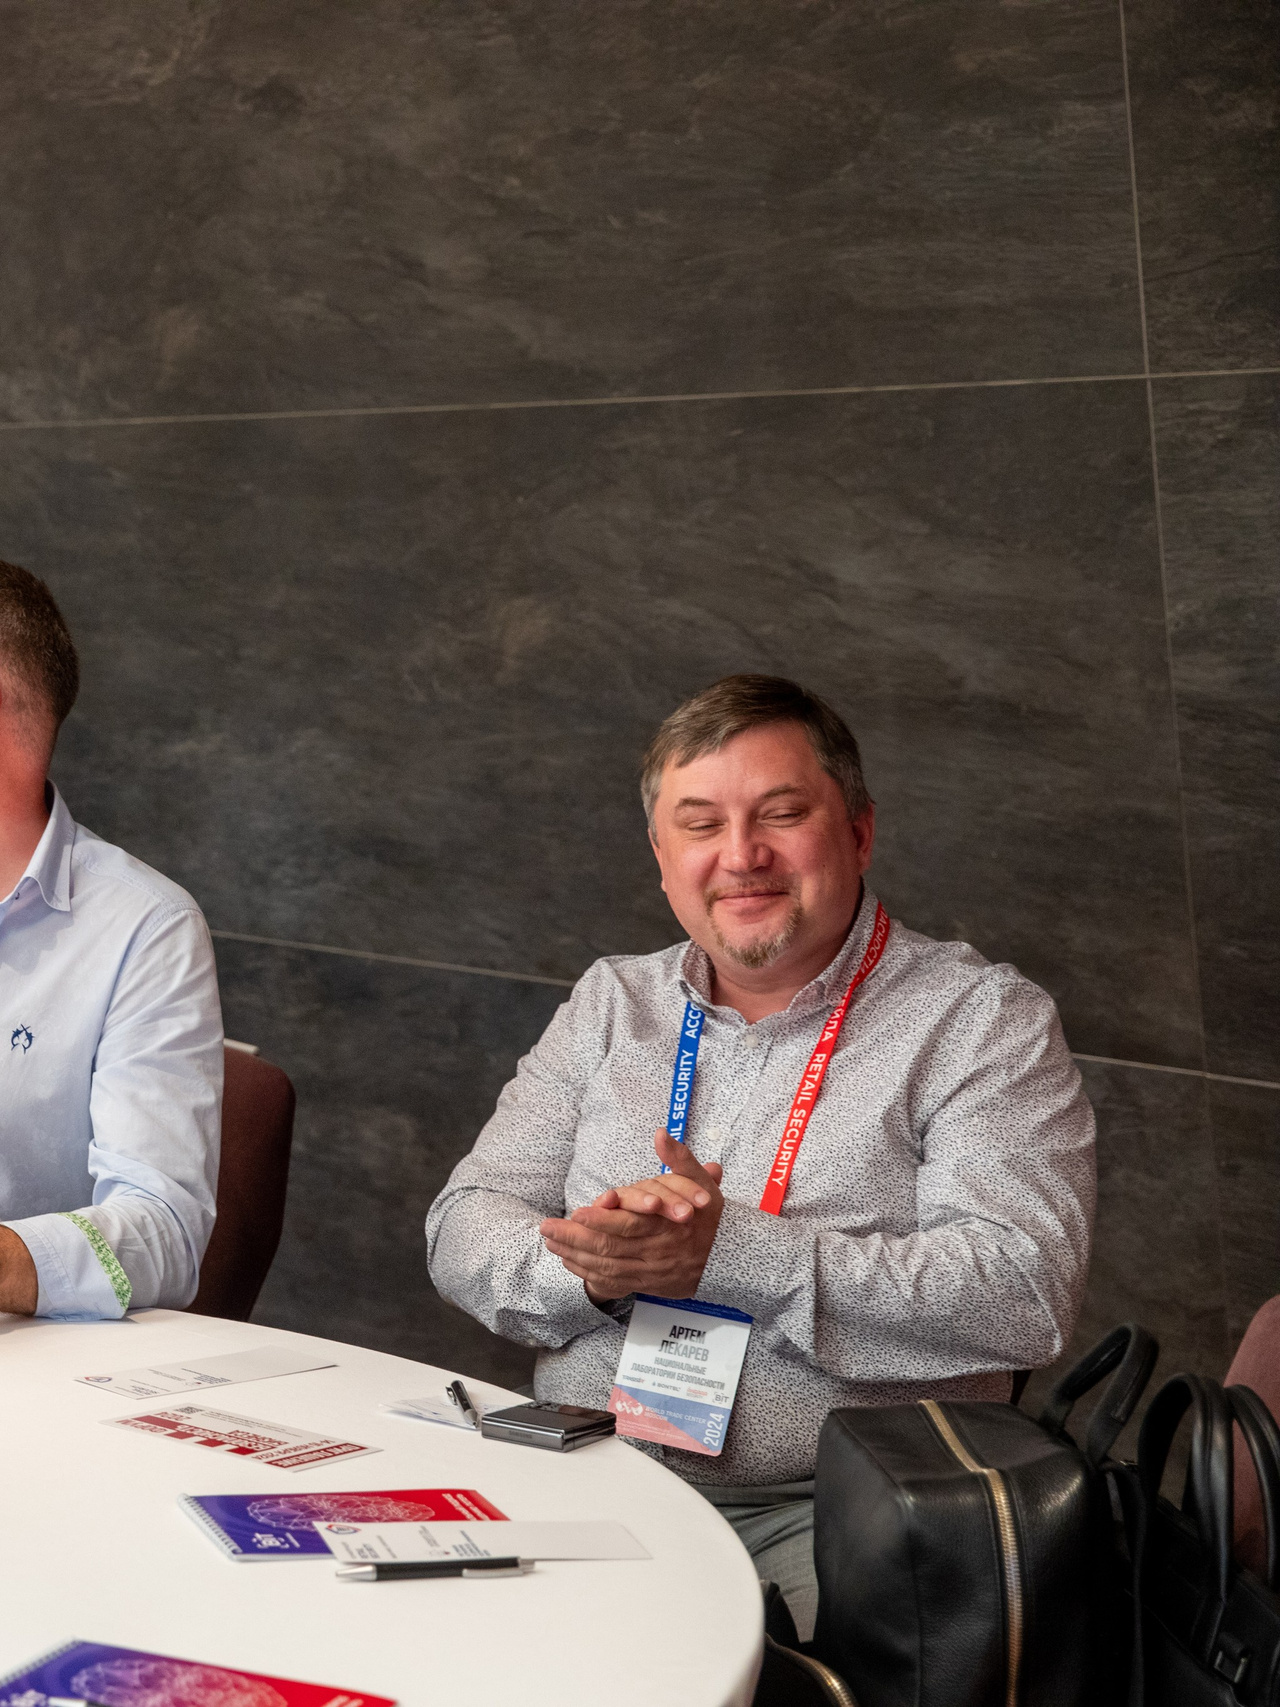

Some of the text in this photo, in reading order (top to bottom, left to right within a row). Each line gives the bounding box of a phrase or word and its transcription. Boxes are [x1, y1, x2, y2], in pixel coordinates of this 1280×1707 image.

[672, 1049, 694, 1120] SECURITY
[772, 1053, 826, 1186] RETAIL SECURITY
[669, 1324, 707, 1345] АРТЕМ
[658, 1339, 710, 1362] ЛЕКАРЕВ
[630, 1362, 726, 1391] ЛАБОРАТОРИИ БЕЗОПАСНОСТИ
[654, 1357, 707, 1376] НАЦИОНАЛЬНЫЕ
[666, 1410, 683, 1419] TRADE
[684, 1414, 707, 1424] CENTER
[703, 1412, 725, 1447] 2024
